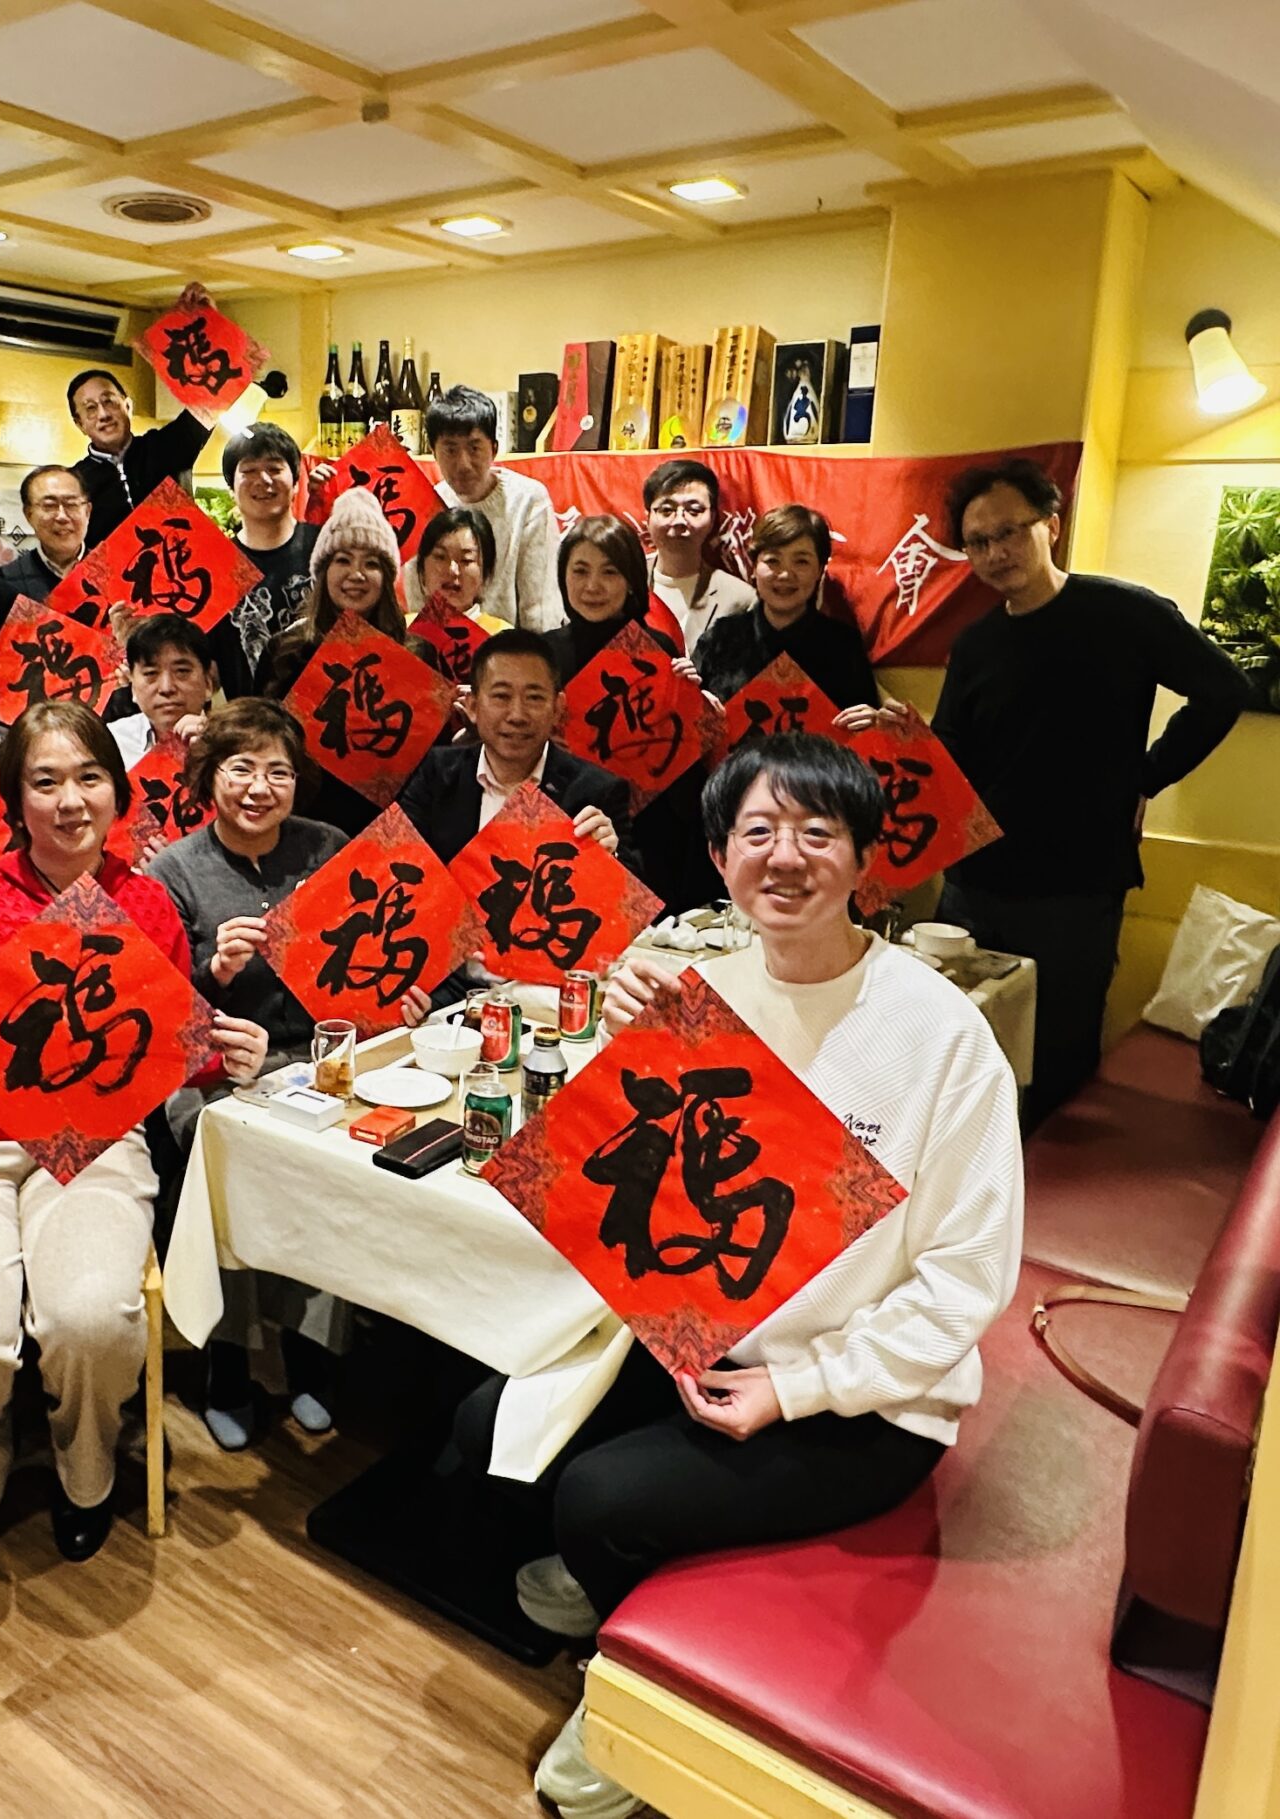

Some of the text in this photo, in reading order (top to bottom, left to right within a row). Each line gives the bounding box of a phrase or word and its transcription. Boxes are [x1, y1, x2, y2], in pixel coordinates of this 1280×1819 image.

[162, 316, 242, 396] 福
[122, 518, 212, 619] 福
[312, 653, 413, 760] 福
[584, 658, 684, 779] 福
[316, 862, 431, 1008] 福
[478, 842, 603, 970] 福
[581, 1066, 796, 1301] 福
